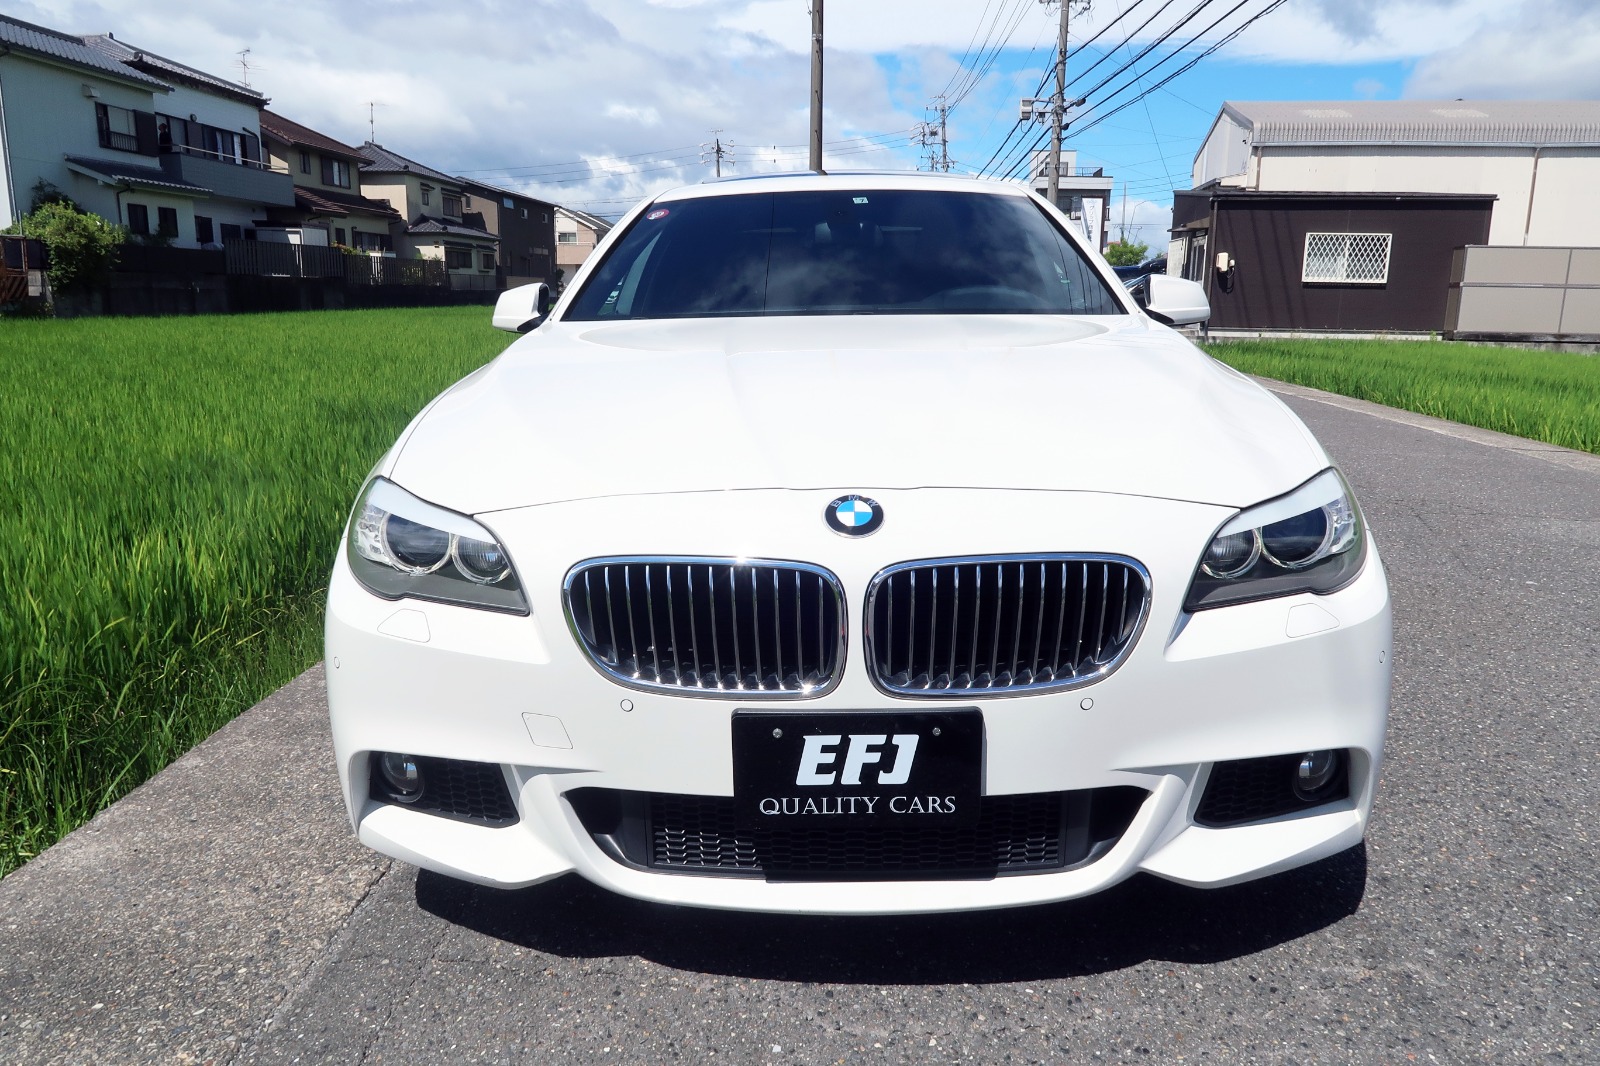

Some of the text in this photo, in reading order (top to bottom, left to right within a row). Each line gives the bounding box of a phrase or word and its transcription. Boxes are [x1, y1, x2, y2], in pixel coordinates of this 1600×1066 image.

[830, 495, 879, 508] BMW
[795, 734, 920, 786] EFJ
[759, 796, 956, 815] QUALITY CARS
